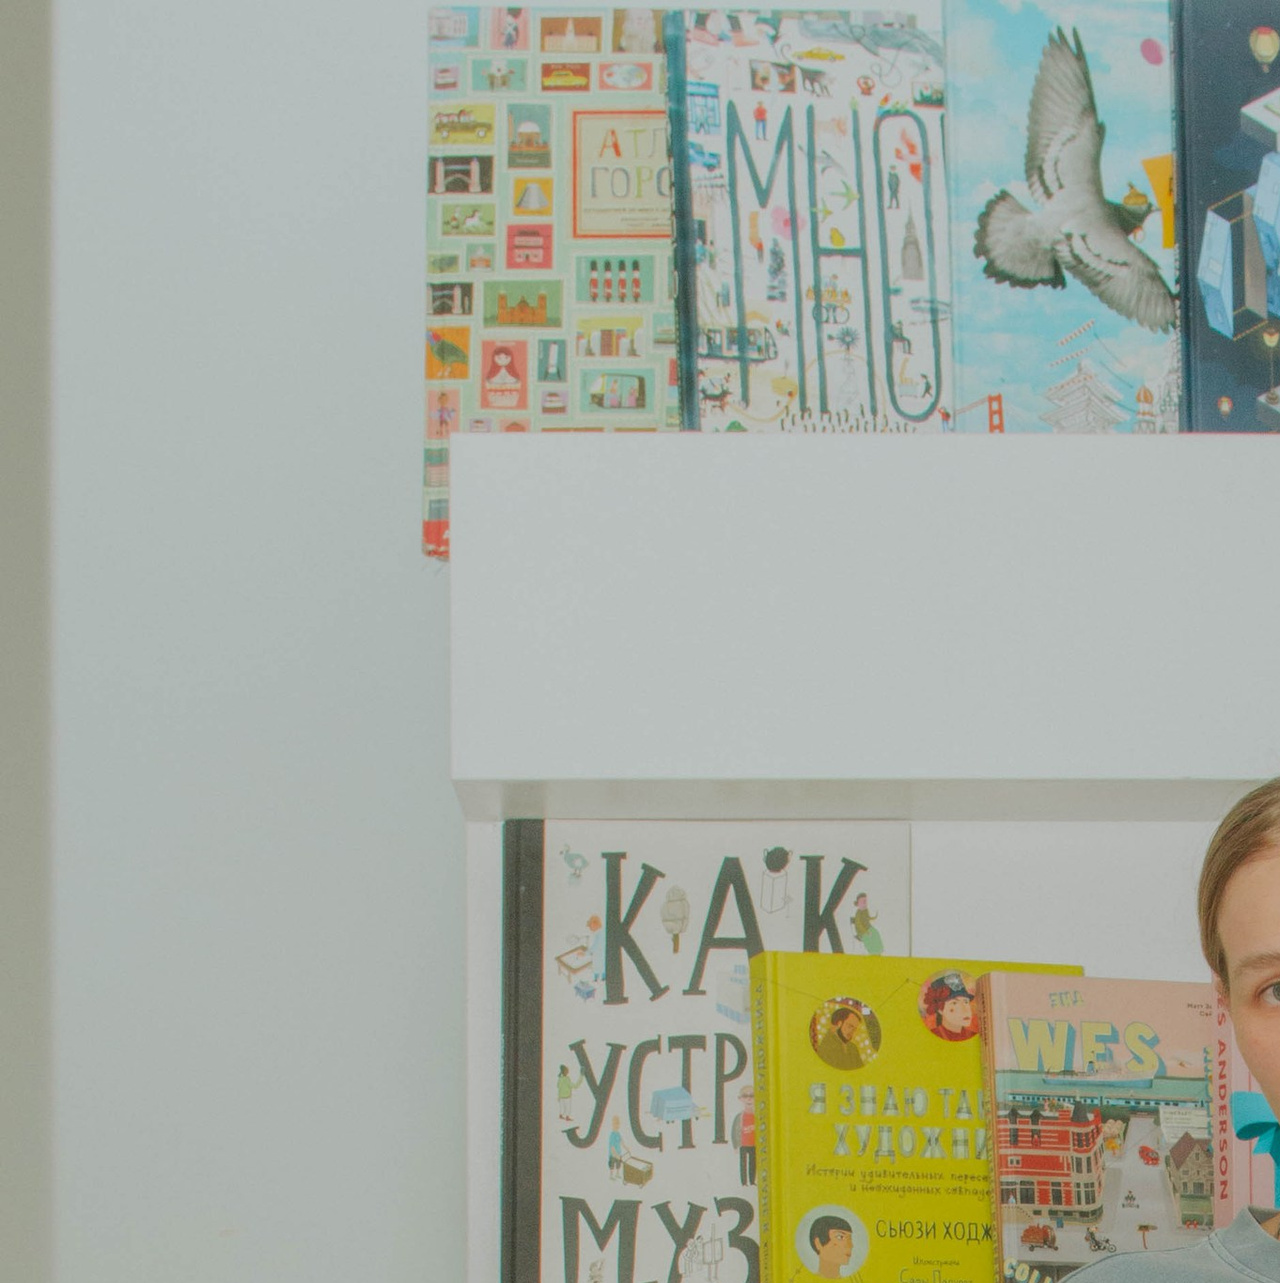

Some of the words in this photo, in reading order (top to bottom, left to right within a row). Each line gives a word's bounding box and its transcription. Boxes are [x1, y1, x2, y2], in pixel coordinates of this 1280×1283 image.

[726, 99, 949, 421] МНО
[601, 851, 868, 1005] КАК
[809, 1082, 827, 1115] Я
[839, 1084, 929, 1118] ЗНАЮ
[1217, 1039, 1229, 1200] ANDERSON
[860, 1168, 944, 1183] удивительных
[861, 1184, 941, 1198] неожиданных
[876, 1220, 936, 1240] СЬЮЗИ
[943, 1221, 993, 1246] ХОДЖ
